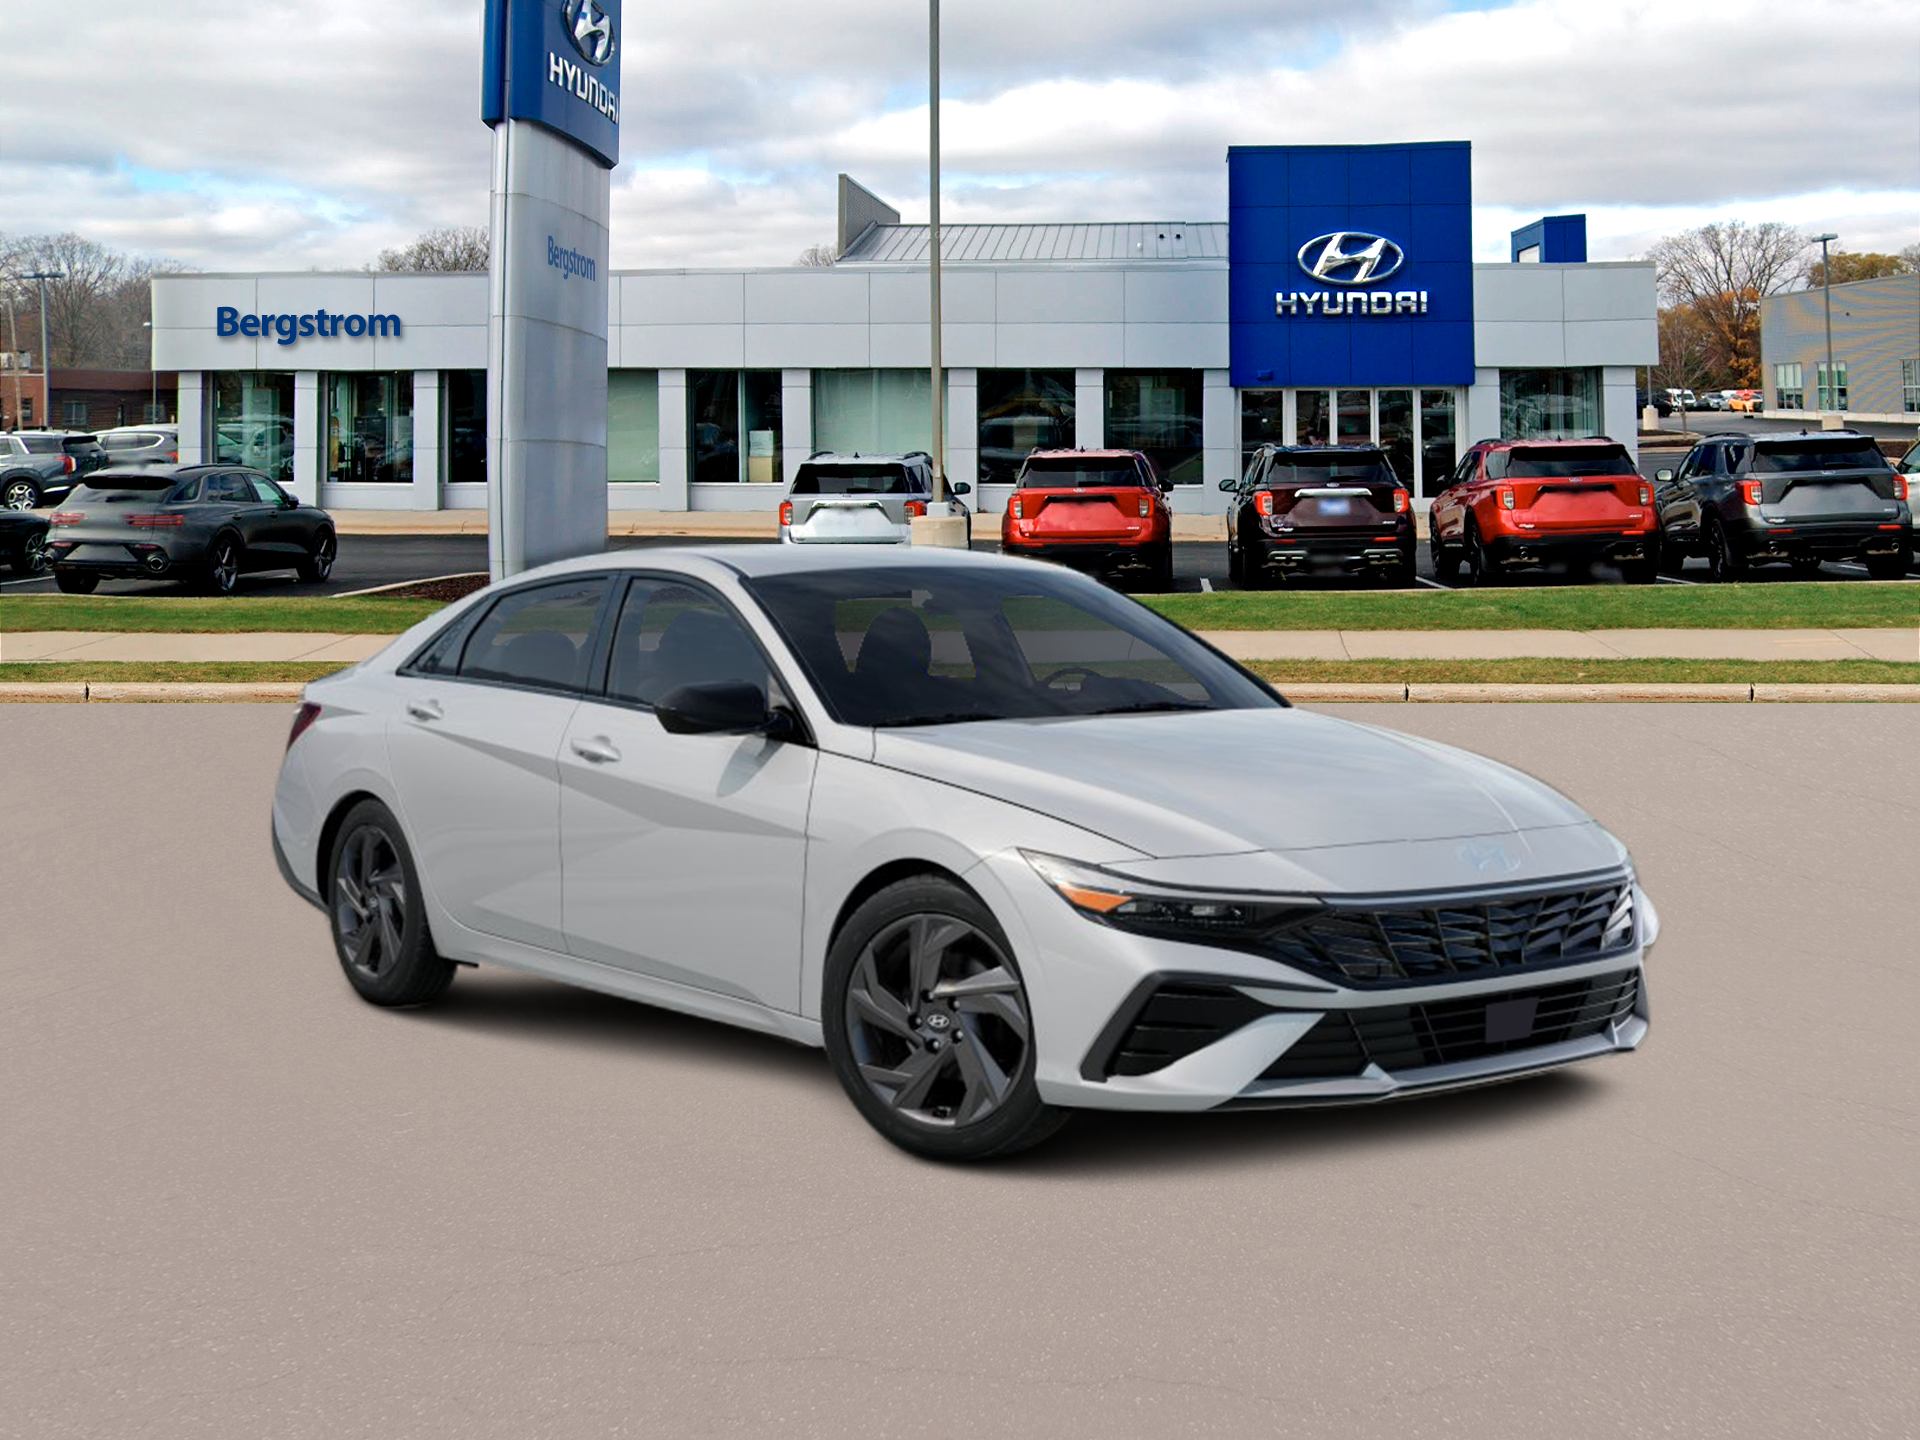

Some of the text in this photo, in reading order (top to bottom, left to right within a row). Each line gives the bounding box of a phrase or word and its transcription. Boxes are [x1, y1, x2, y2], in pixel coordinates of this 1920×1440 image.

[550, 52, 619, 124] HYUNDAI
[547, 235, 596, 282] Bergstrom
[1275, 291, 1428, 315] HYUNDAI
[216, 306, 402, 346] Bergstrom
